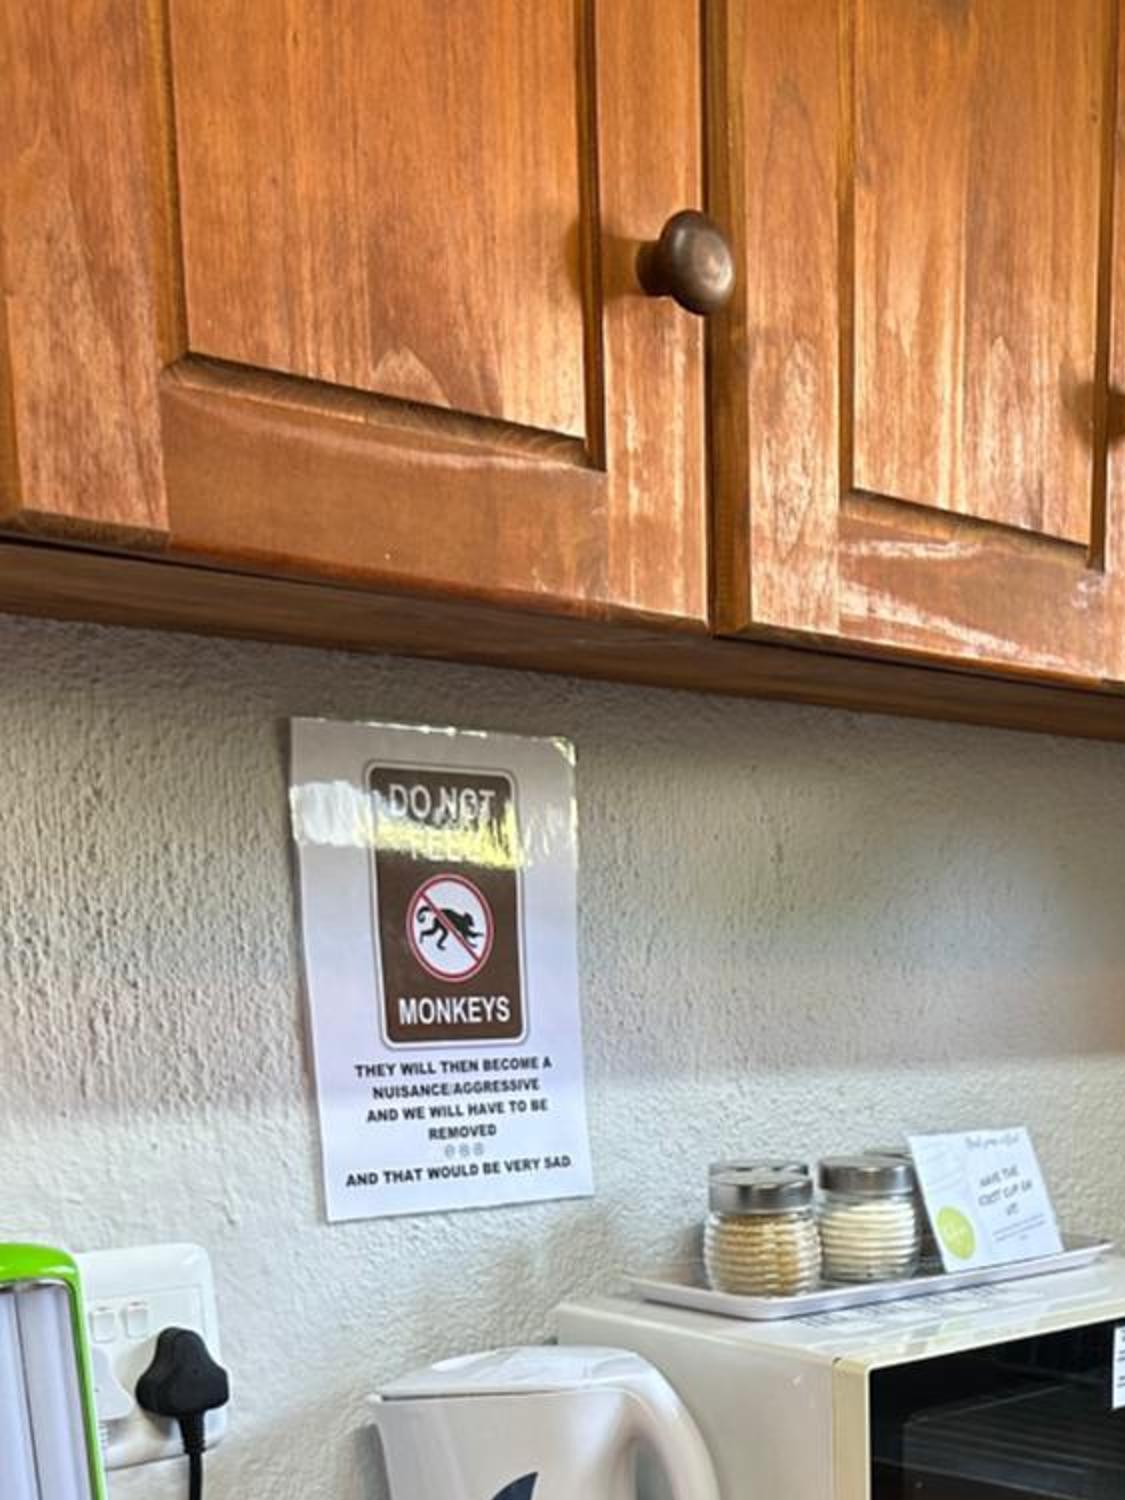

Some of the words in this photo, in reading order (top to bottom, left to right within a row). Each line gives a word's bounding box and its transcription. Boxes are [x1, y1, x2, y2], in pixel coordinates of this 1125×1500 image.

[389, 783, 432, 819] DO
[439, 786, 496, 822] NOT
[398, 995, 511, 1025] MONKEYS
[354, 1062, 396, 1078] THEY
[399, 1061, 437, 1076] WILL
[439, 1059, 479, 1074] THEN
[482, 1056, 539, 1072] BECOME
[542, 1056, 553, 1069] A
[366, 1107, 399, 1123] AND
[401, 1105, 426, 1120] WE
[428, 1103, 464, 1118] WILL
[466, 1100, 505, 1117] HAVE
[507, 1099, 527, 1113] TO
[529, 1097, 548, 1112] BE
[427, 1122, 497, 1141] REMOVED
[345, 1171, 379, 1187] AND
[382, 1167, 423, 1183] THAT
[426, 1162, 479, 1180] WOULD
[482, 1160, 501, 1175] BE
[503, 1158, 541, 1173] VERY
[543, 1154, 572, 1170] SAD
